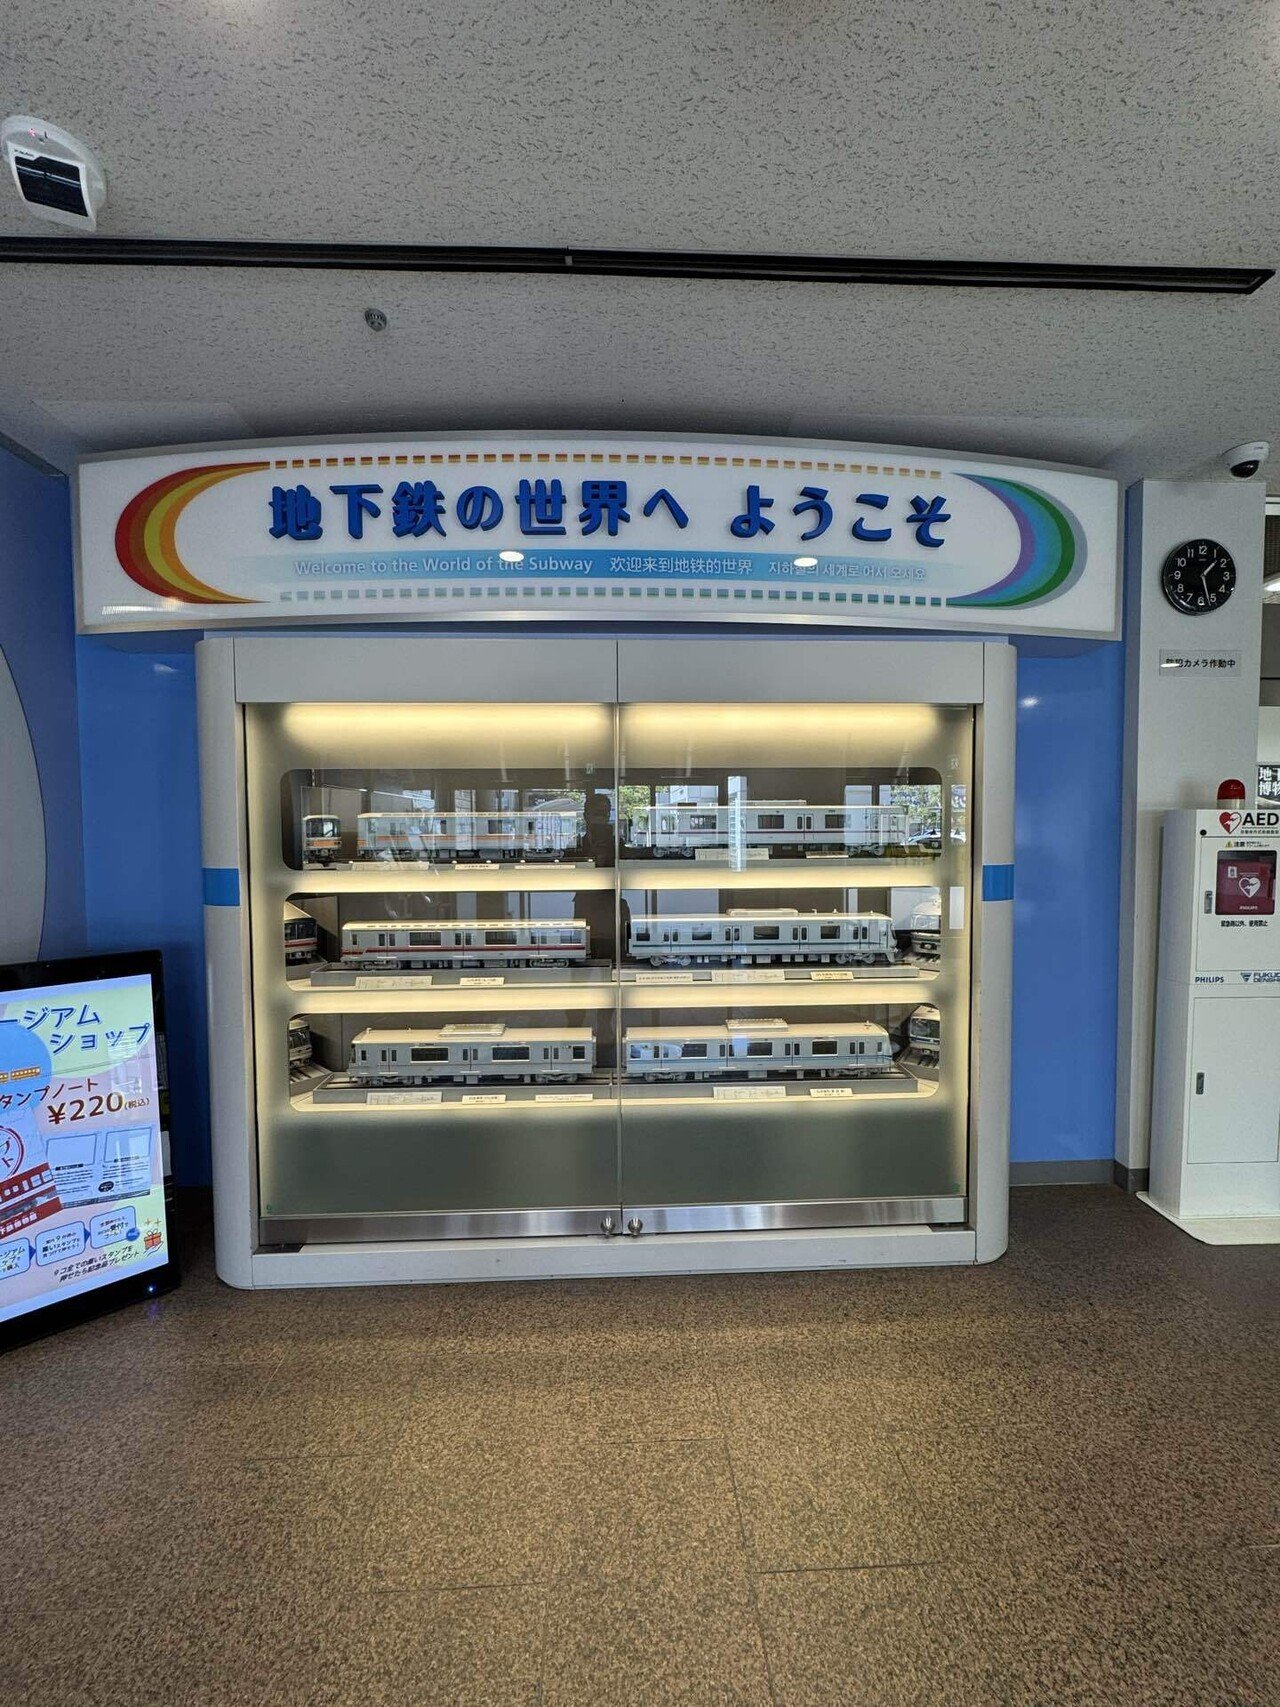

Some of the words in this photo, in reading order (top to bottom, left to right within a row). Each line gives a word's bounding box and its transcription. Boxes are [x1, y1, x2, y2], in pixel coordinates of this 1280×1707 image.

[269, 479, 689, 540] 地下鉄の世界へ
[730, 485, 951, 548] ようこそ
[1187, 548, 1194, 558] 11
[1199, 545, 1208, 555] 12
[1213, 549, 1217, 558] 1
[295, 560, 366, 575] Welcome
[370, 560, 387, 573] to
[392, 558, 418, 573] the
[422, 557, 471, 571] World
[476, 557, 493, 571] of
[529, 557, 593, 574] Subway
[610, 557, 753, 575] 欢迎来到地铁的世界
[1177, 557, 1187, 567] 10
[1220, 558, 1227, 568] 2
[1173, 570, 1181, 580] 9
[1223, 571, 1230, 581] 3
[1177, 583, 1184, 593] 8
[1218, 584, 1226, 593] 4
[1186, 592, 1194, 602] 7
[1197, 596, 1205, 606] 6
[1210, 593, 1217, 603] 5
[1242, 812, 1279, 826] AED
[1194, 976, 1225, 984] PHILIPS
[49, 1022, 150, 1054] ショップ
